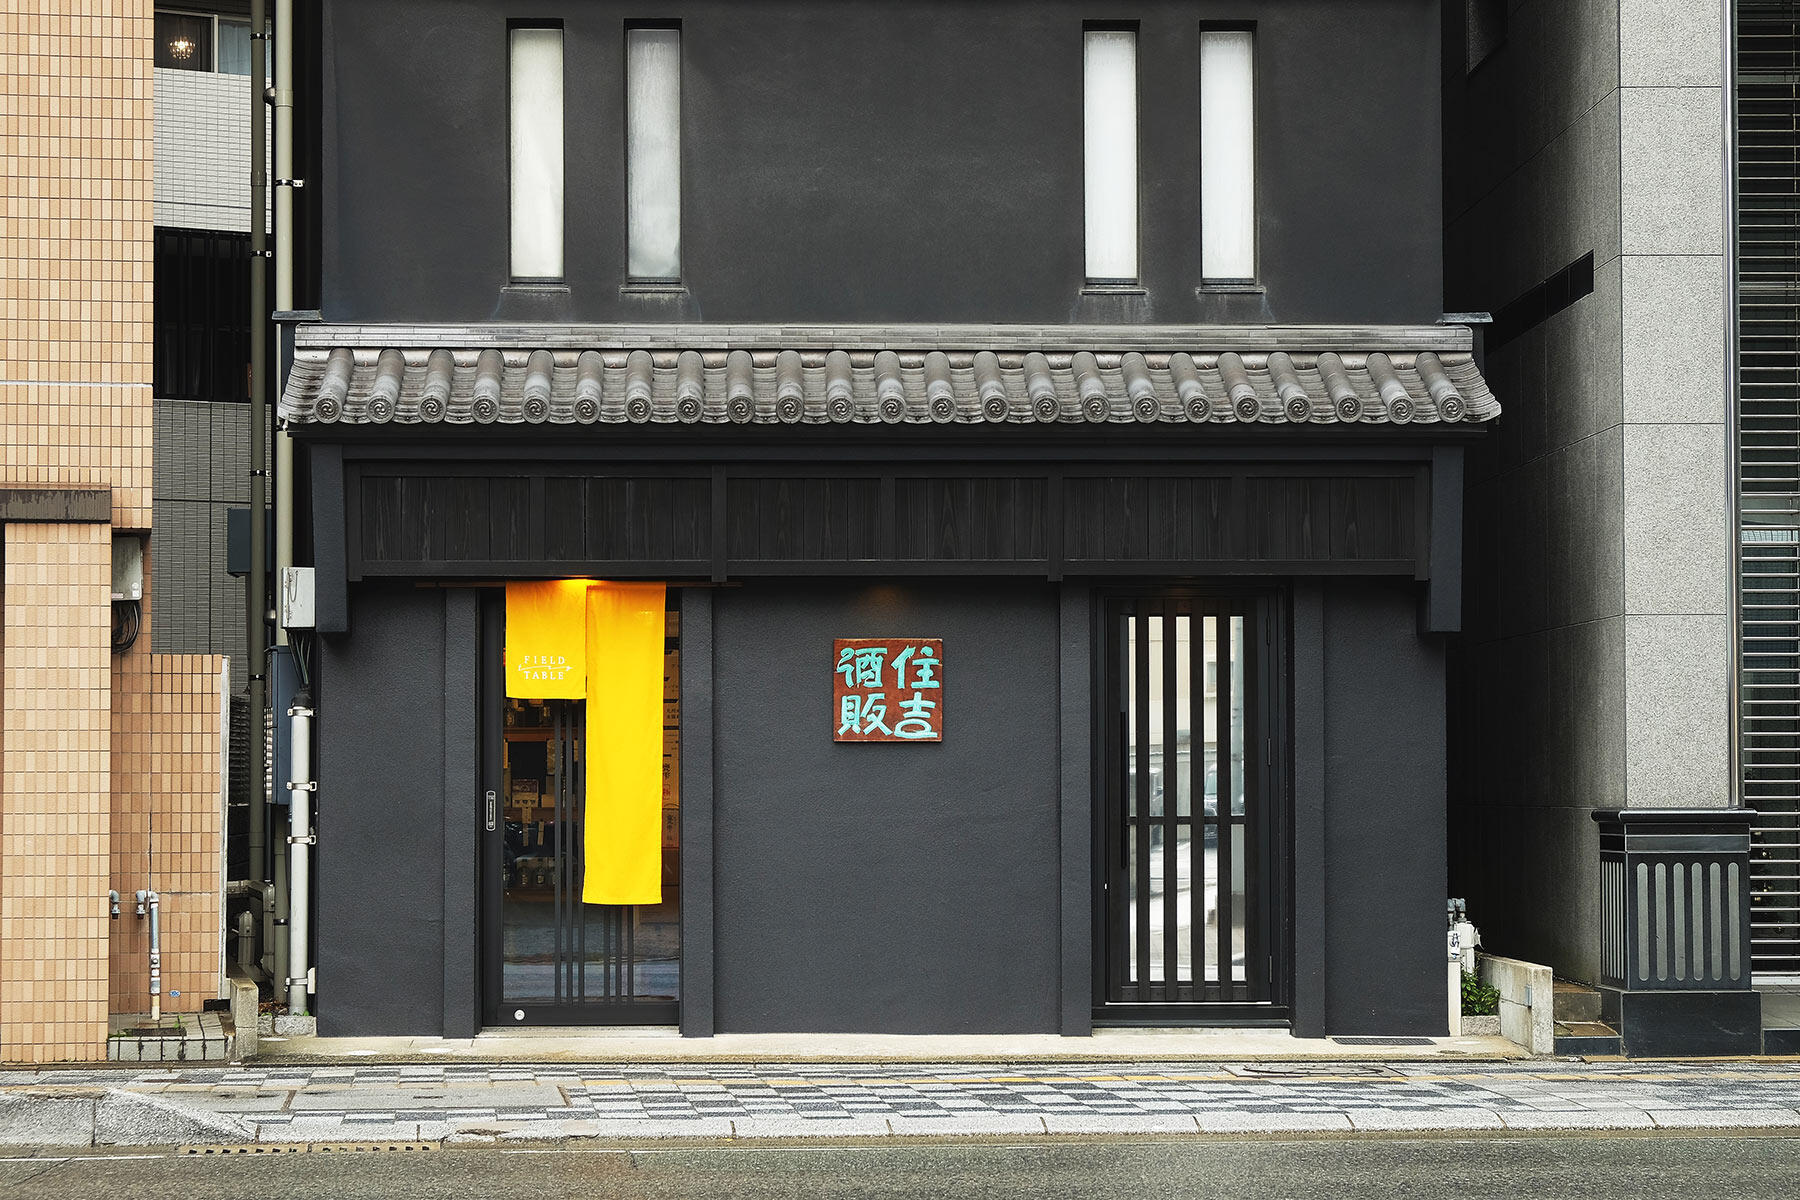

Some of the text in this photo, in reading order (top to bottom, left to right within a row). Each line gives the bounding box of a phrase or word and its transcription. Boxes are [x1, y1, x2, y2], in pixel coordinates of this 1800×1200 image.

[524, 655, 565, 664] FIELD
[524, 671, 564, 680] TABLE
[836, 647, 893, 736] 酒販
[890, 645, 940, 739] 住吉
